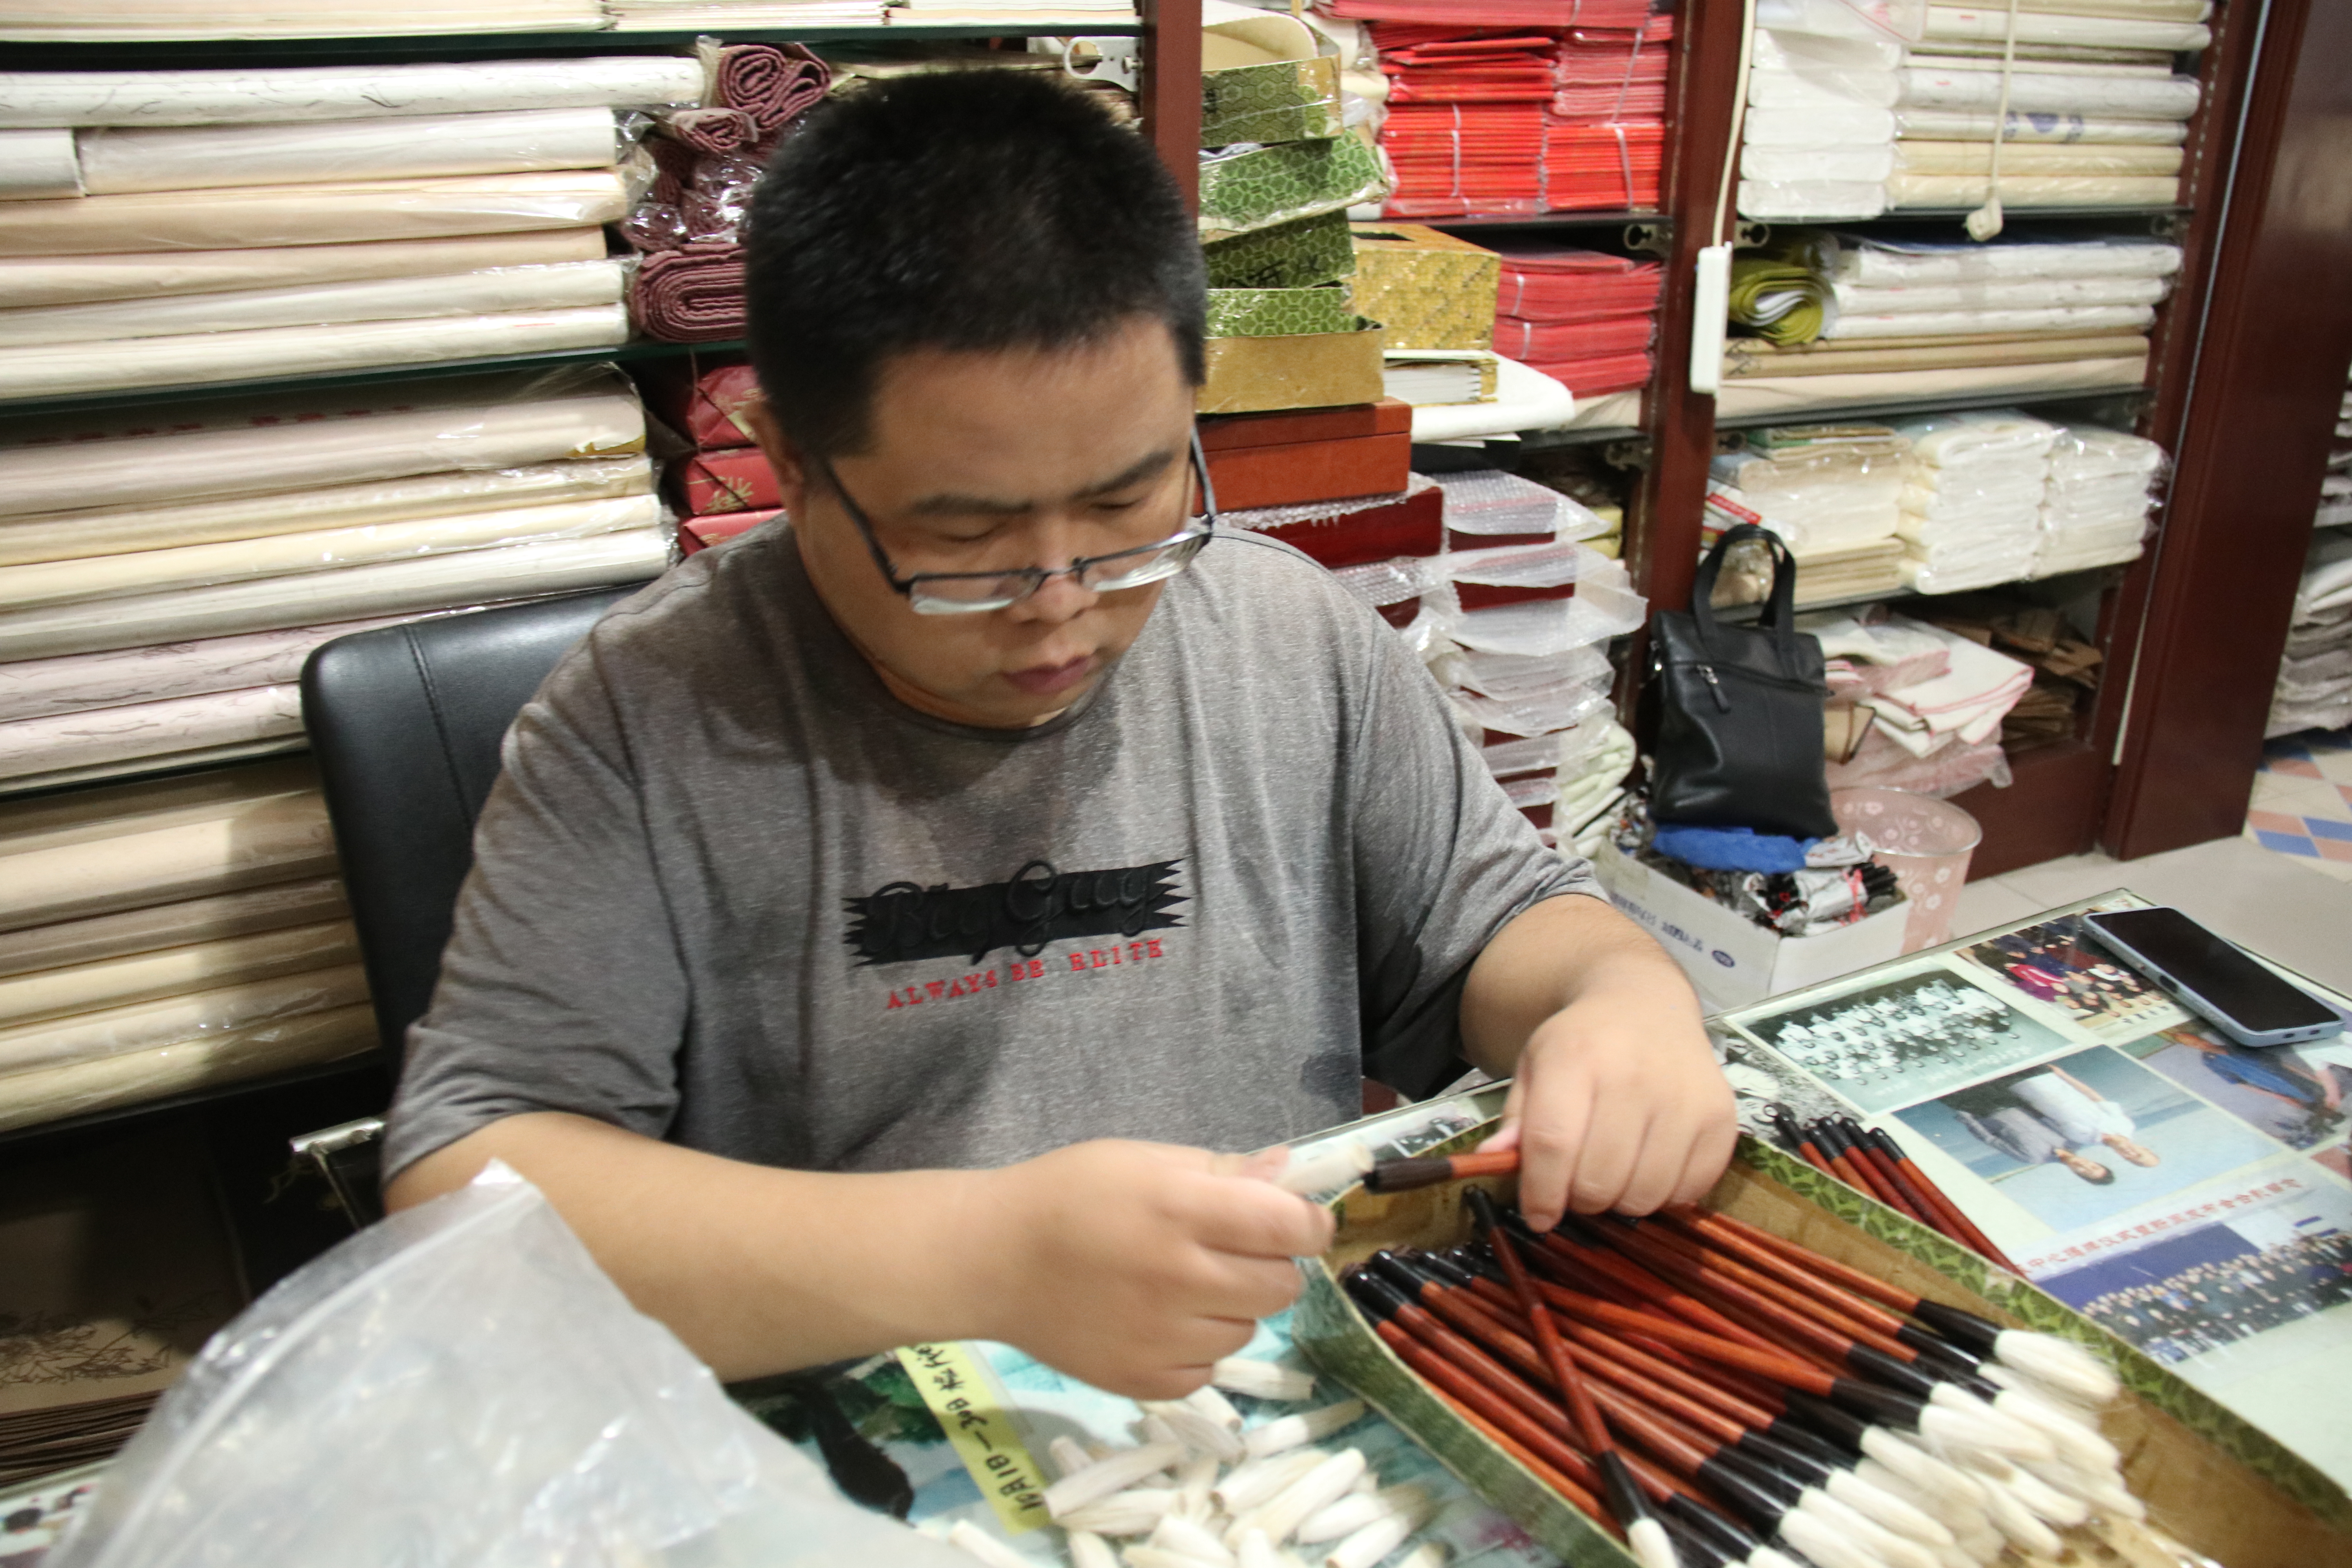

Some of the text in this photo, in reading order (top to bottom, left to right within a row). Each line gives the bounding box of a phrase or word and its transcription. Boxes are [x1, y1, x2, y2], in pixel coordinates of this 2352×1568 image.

[1005, 860, 1169, 957] Guy
[887, 938, 1163, 1009] ALWAYS BE ELITE
